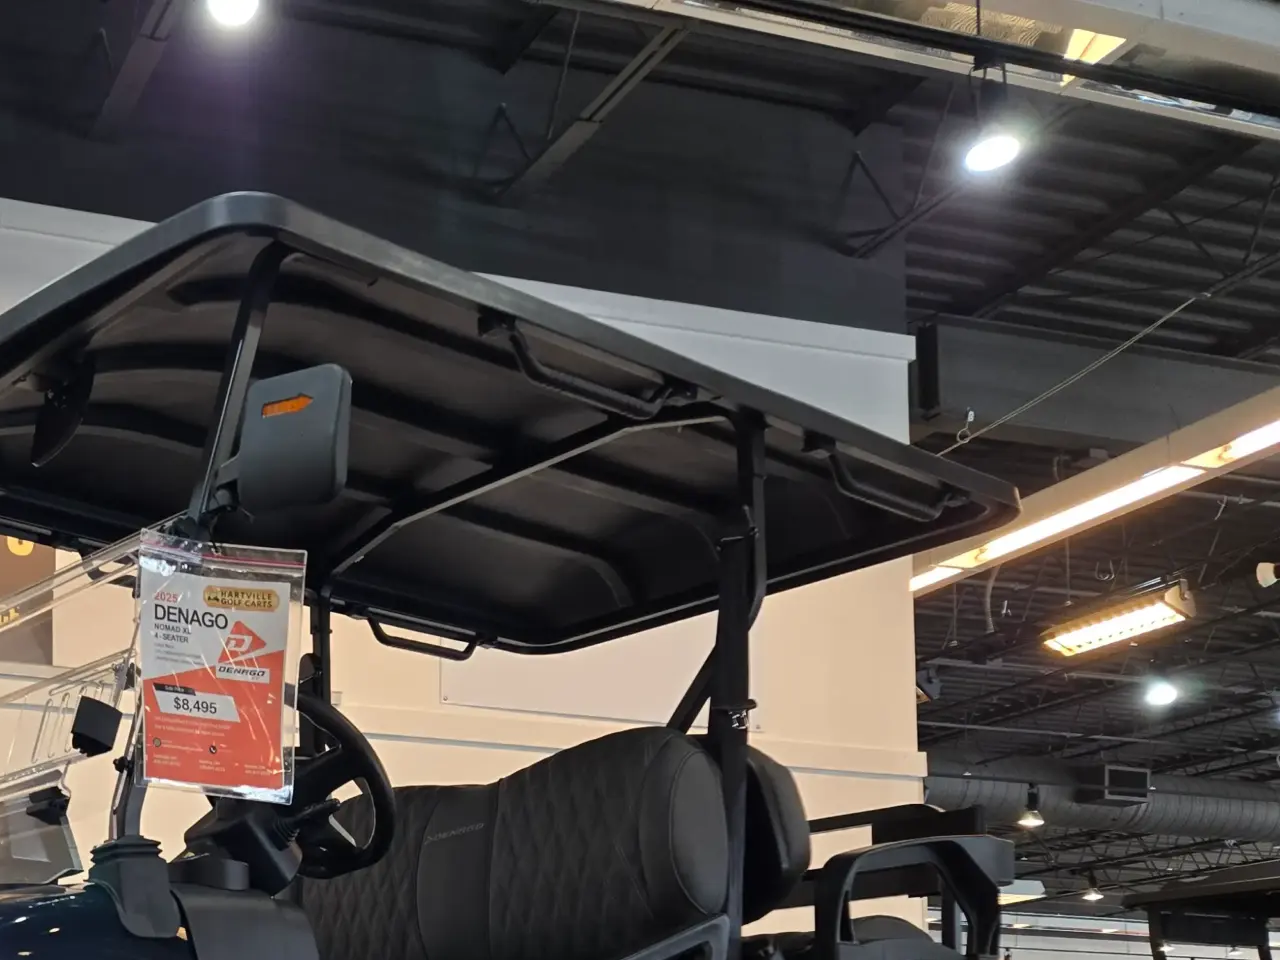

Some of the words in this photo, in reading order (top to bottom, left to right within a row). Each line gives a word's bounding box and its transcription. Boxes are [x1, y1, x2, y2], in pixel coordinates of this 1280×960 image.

[154, 591, 179, 603] 2025
[221, 591, 272, 600] HARTVILLE
[221, 598, 242, 606] GOLF
[244, 599, 273, 608] CARTS
[154, 603, 229, 630] DENAGO
[154, 623, 181, 633] NOMAD
[218, 665, 266, 677] DENAGO
[173, 696, 217, 714] $8,495
